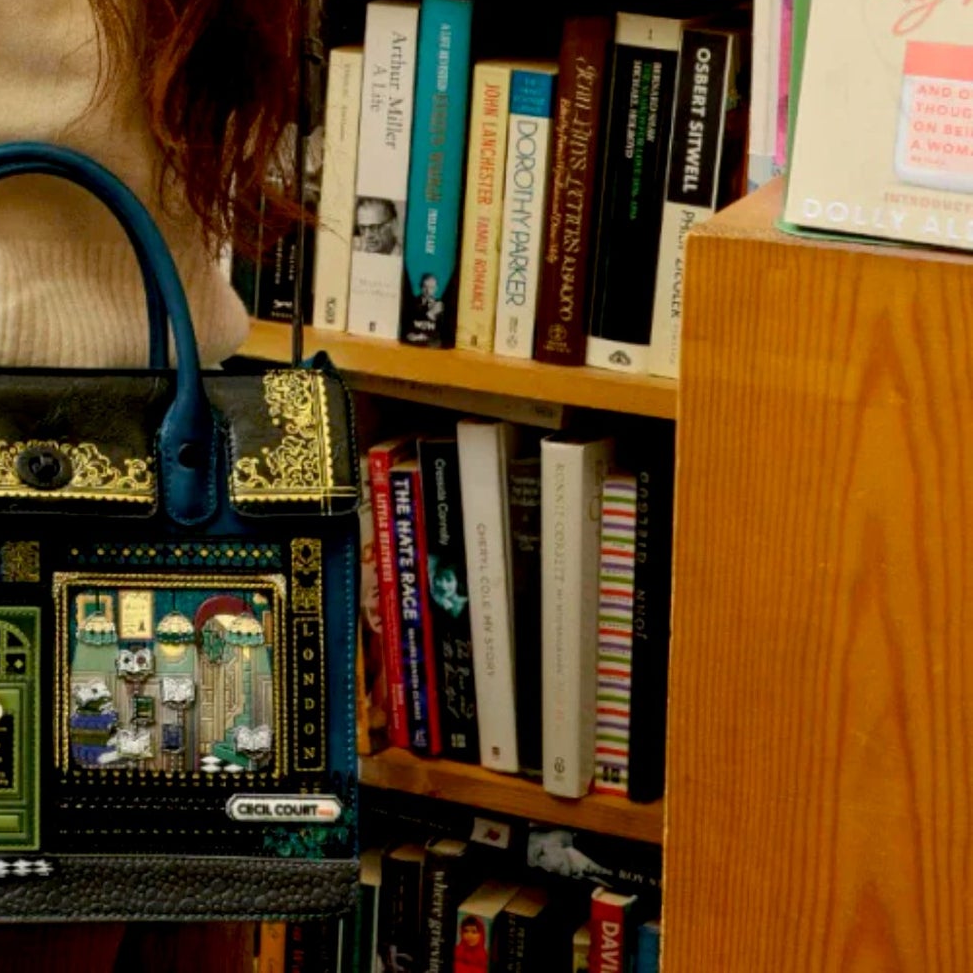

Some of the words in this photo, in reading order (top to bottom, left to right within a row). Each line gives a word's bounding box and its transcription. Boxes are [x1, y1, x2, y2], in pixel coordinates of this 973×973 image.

[390, 30, 409, 94] Arthur
[691, 46, 713, 120] OSBERT
[483, 83, 501, 116] JOHN
[916, 83, 953, 100] AND
[958, 88, 973, 101] O
[384, 94, 404, 151] Miller
[910, 139, 922, 152] A
[912, 120, 938, 135] ON
[476, 121, 500, 205] LANCHESTER
[512, 119, 538, 227] DOROTHY
[680, 118, 706, 195] SITWELL
[473, 215, 491, 257] FAMILY
[802, 196, 908, 231] DOLLY
[469, 257, 490, 313] ROMANCE
[505, 227, 531, 308] PARKER
[393, 478, 412, 516] THE
[395, 518, 415, 570] HATE
[476, 521, 489, 573] CHERYL
[398, 571, 420, 622] RACE
[479, 576, 491, 608] COLE
[483, 635, 497, 678] STORY
[302, 622, 316, 762] LONDON
[237, 803, 273, 817] CECIL
[274, 803, 318, 817] COURT
